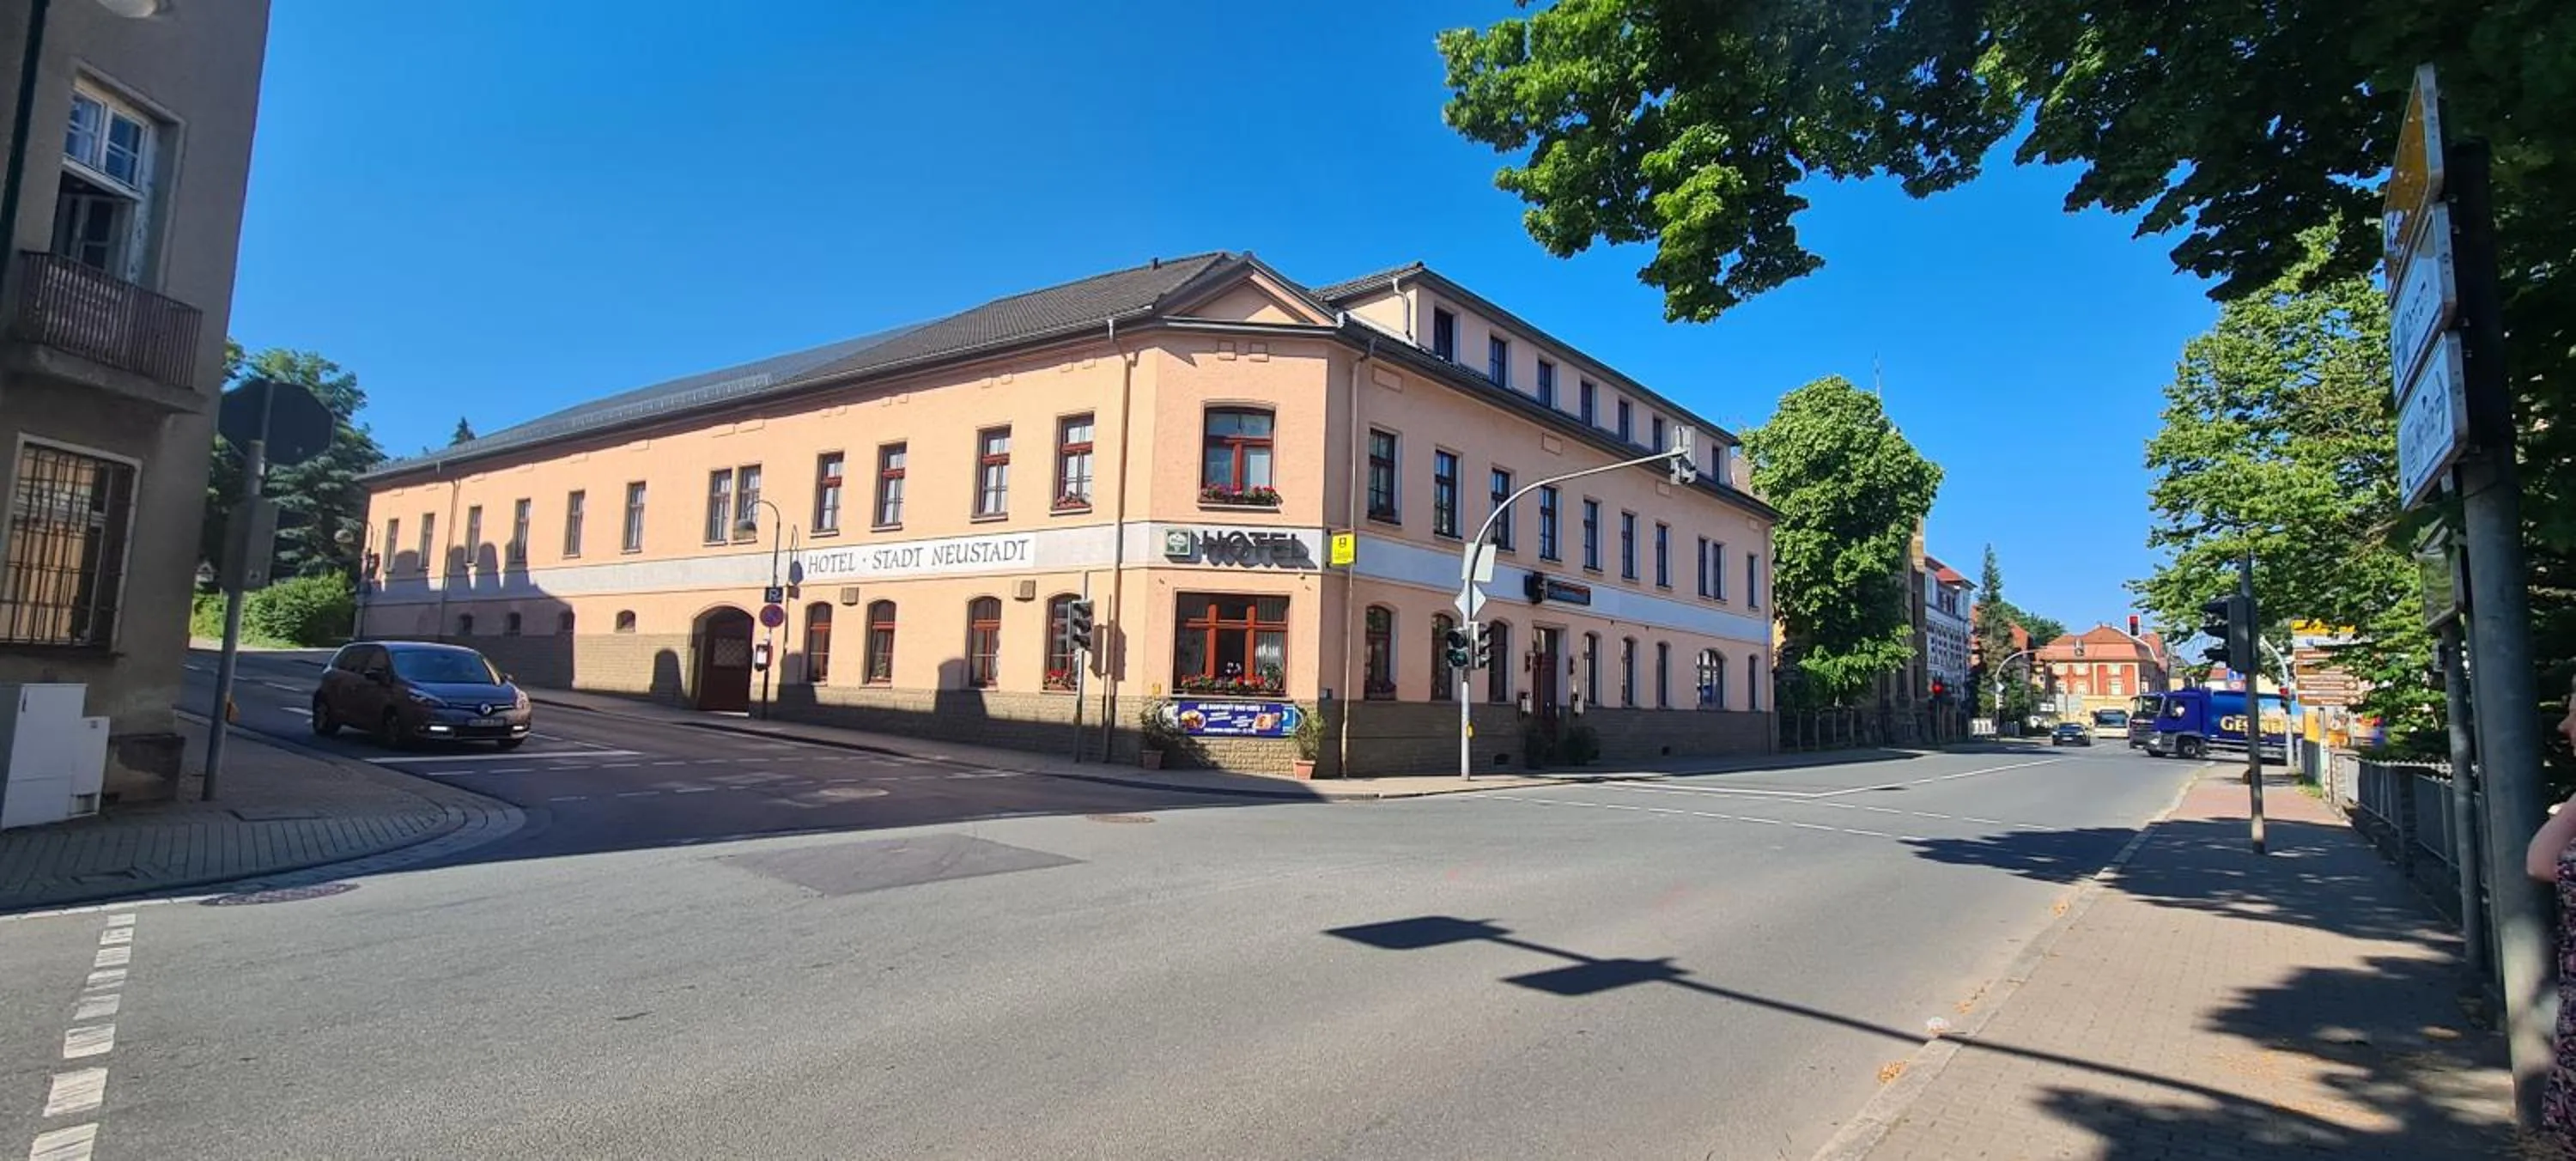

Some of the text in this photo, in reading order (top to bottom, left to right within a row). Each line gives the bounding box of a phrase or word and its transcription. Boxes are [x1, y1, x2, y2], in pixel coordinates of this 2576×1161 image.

[807, 539, 1030, 574] HOTEL STADT NEUSTADT
[1202, 530, 1309, 559] HOTEL
